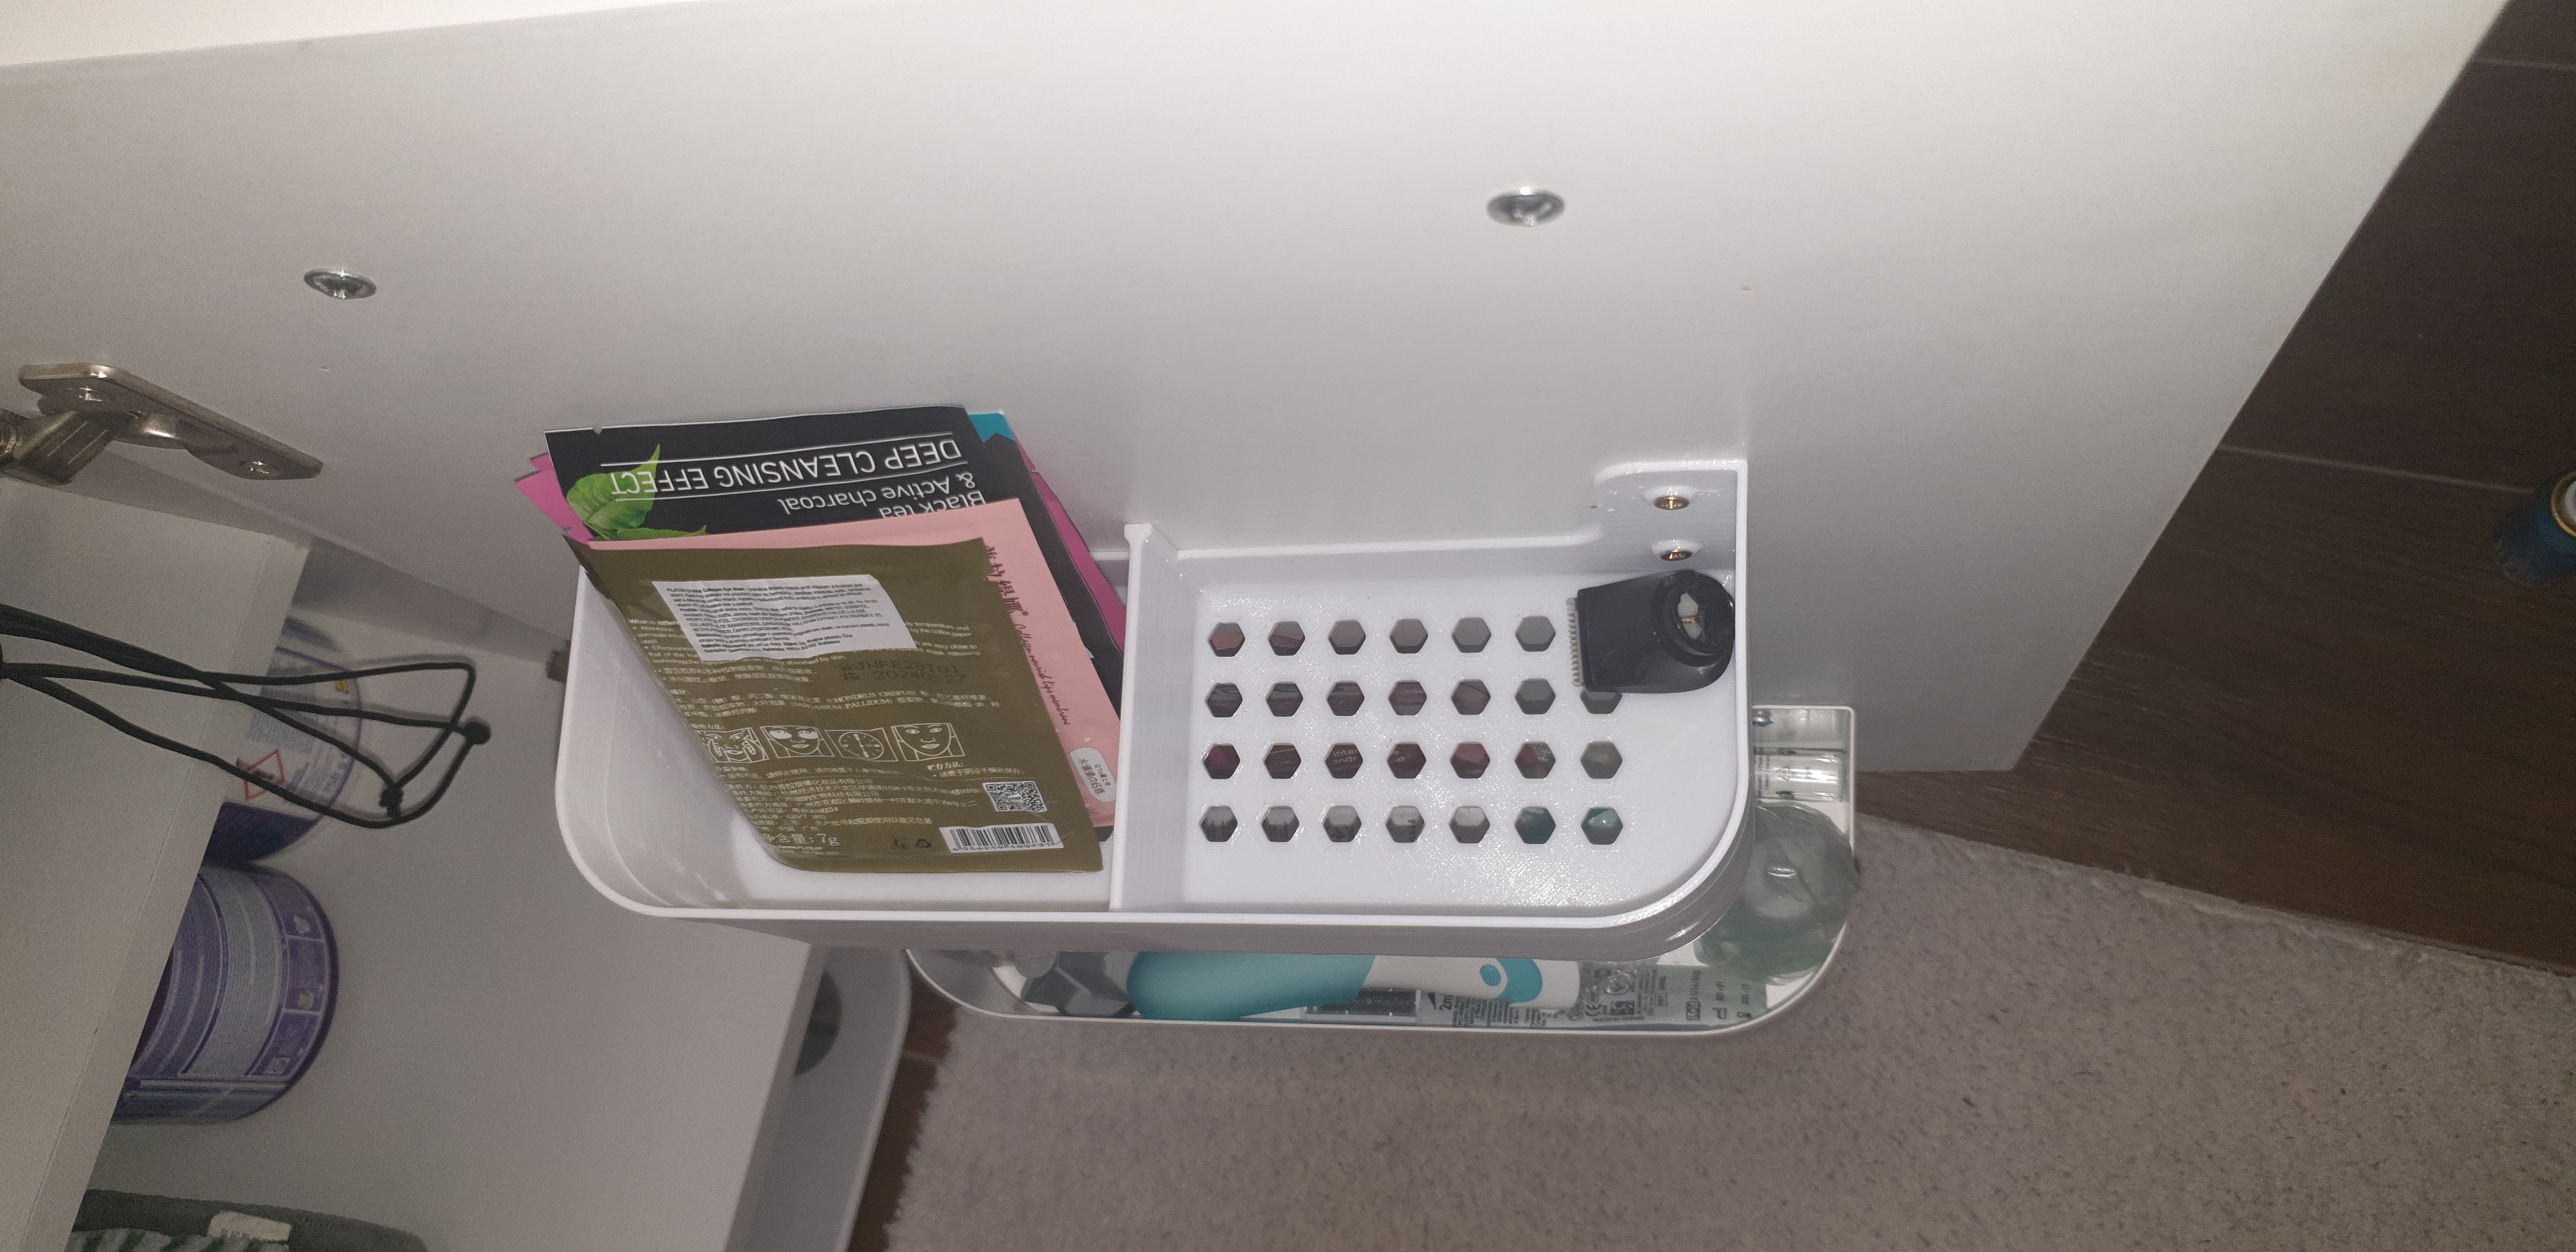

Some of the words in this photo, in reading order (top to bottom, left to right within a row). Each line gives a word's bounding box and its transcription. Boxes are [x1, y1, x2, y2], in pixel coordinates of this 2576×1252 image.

[884, 439, 963, 470] DEEP
[610, 468, 710, 495] EFFECT
[714, 450, 876, 488] CLEANSING
[955, 472, 976, 489] &
[882, 475, 950, 501] Active
[777, 489, 877, 515] charcoal
[919, 490, 986, 514] Black
